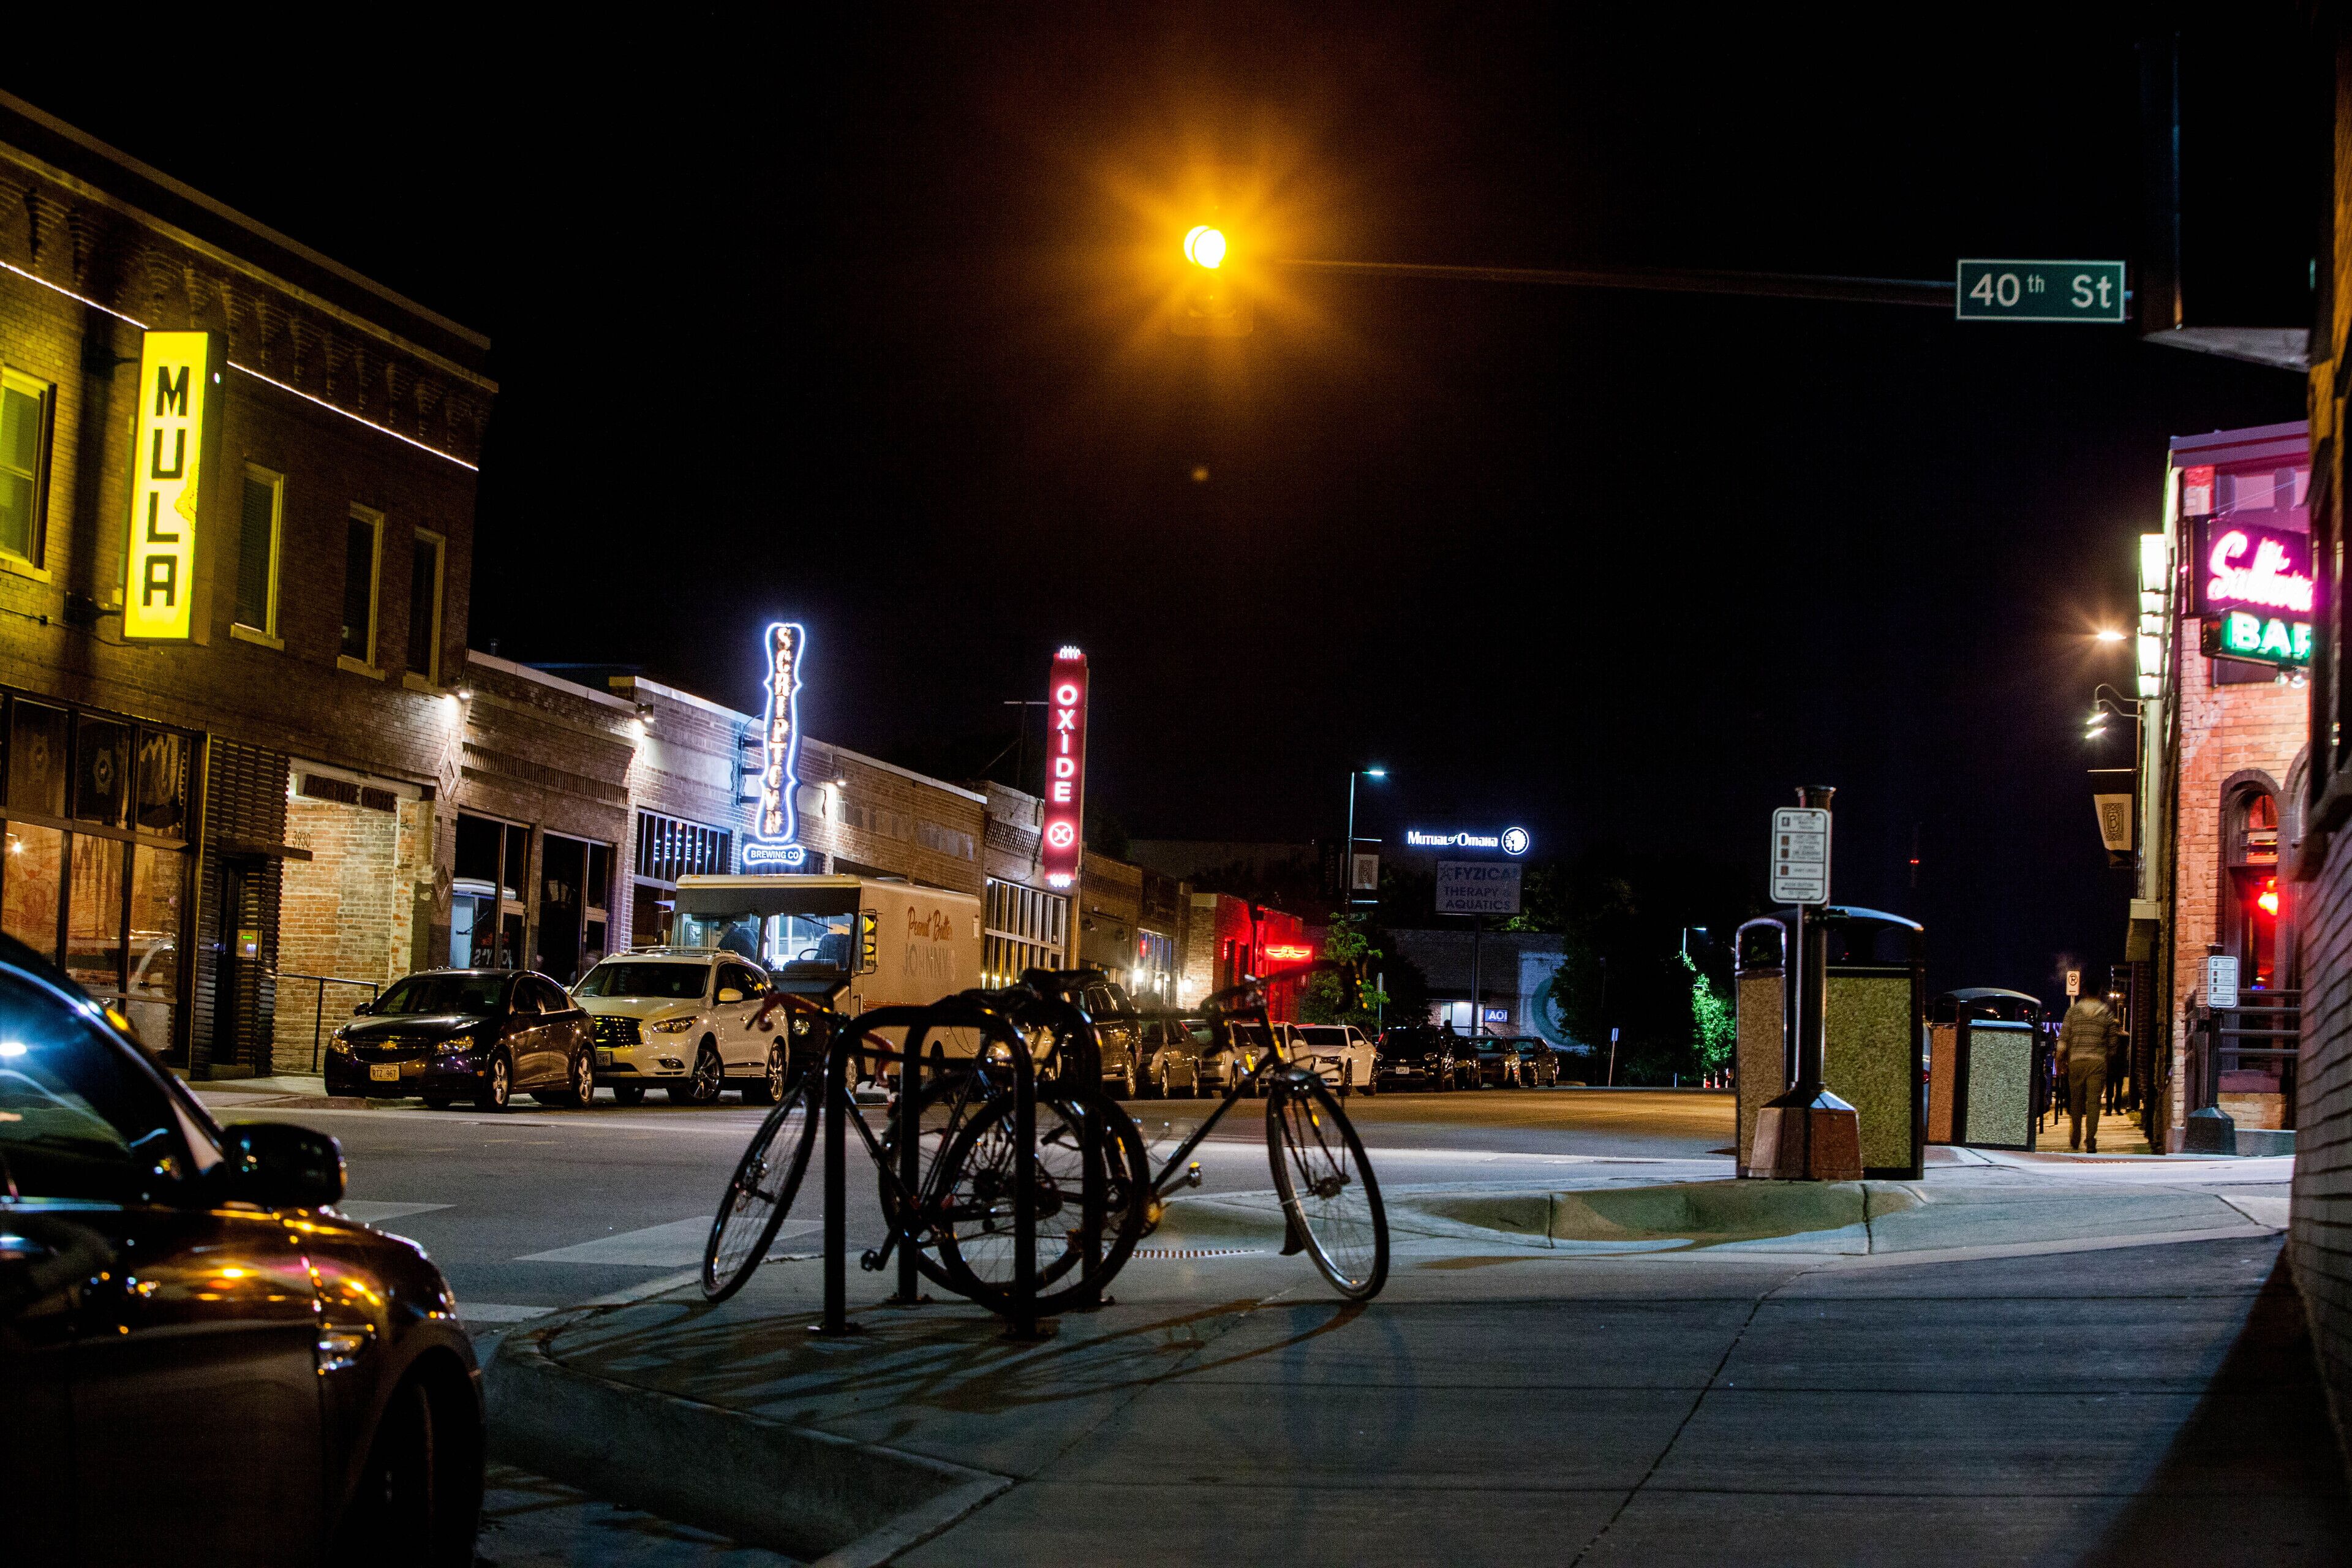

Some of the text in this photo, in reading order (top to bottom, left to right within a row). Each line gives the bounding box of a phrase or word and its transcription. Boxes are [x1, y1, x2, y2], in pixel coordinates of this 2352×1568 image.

[1969, 272, 2112, 309] 40th St
[143, 366, 190, 607] MULA
[765, 627, 792, 834] SCRIPTOWN
[1054, 684, 1078, 802] OXIDE
[292, 831, 311, 848] 3930
[1448, 835, 1458, 845] of
[751, 850, 786, 859] BREWING
[1444, 886, 1499, 897] THERAPY
[1446, 899, 1510, 910] AQUATICS
[1488, 1011, 1507, 1020] AOI
